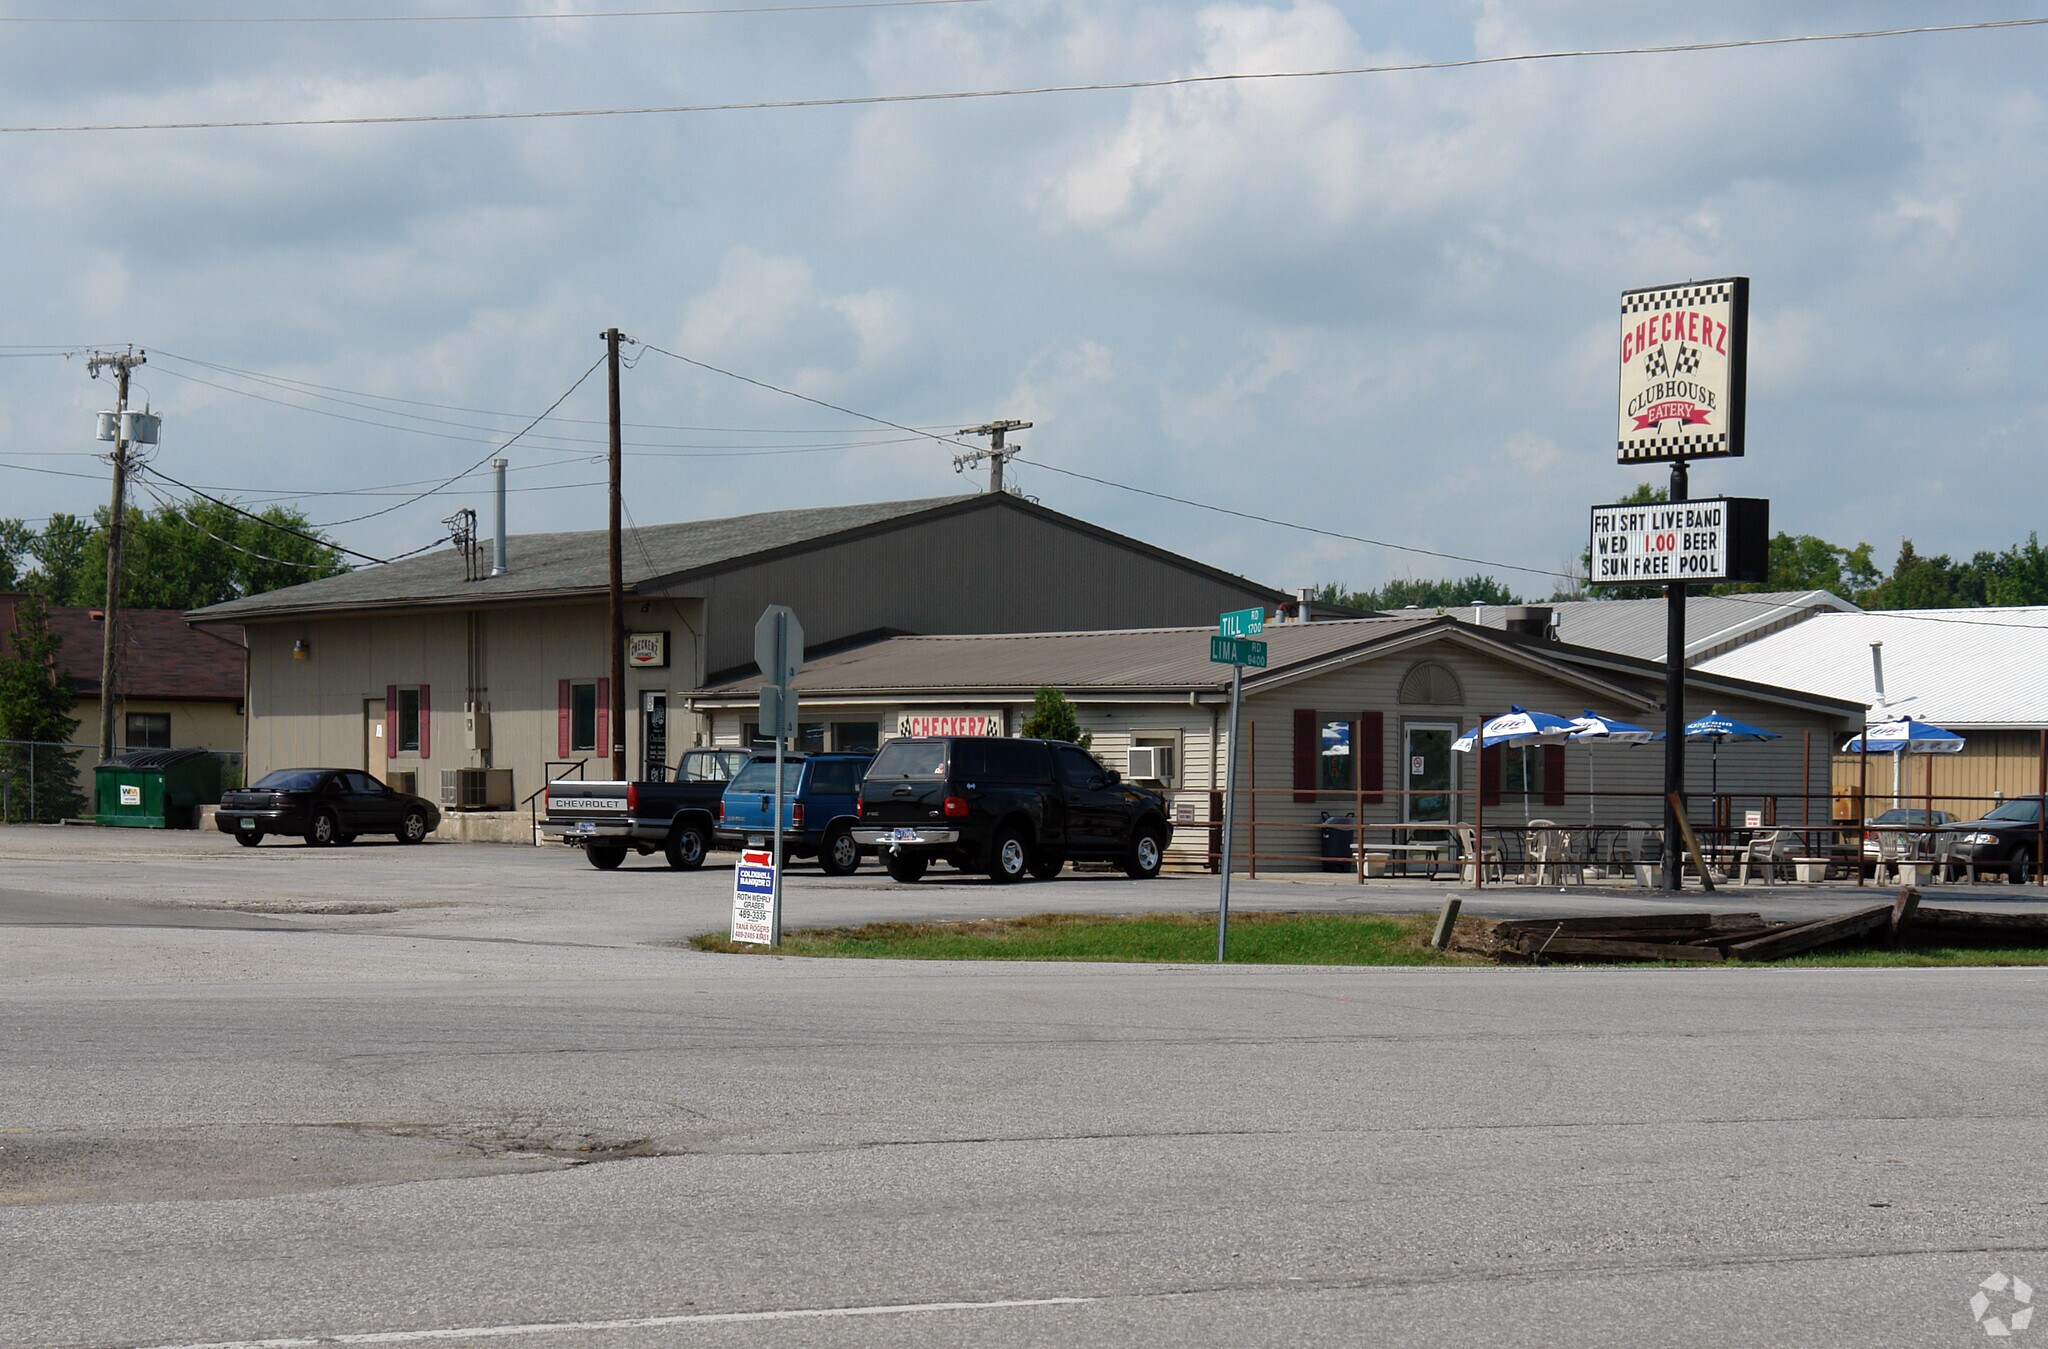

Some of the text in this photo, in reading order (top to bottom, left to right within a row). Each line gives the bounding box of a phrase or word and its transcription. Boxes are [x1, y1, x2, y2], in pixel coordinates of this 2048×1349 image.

[1622, 311, 1727, 365] CHECKERZ
[1627, 380, 1717, 417] CLUBHOUSE
[1648, 403, 1695, 422] EATERY
[1595, 508, 1722, 533] FRI SAT LIVE BAND
[1598, 531, 1717, 554] WED 1.00 BEER
[1601, 554, 1719, 577] SUN FREE POOL
[1223, 610, 1259, 636] TILL RD
[1248, 623, 1262, 633] 1700
[1212, 640, 1261, 661] LIMA RD
[1248, 655, 1265, 666] 9400
[912, 717, 985, 737] CHECKERZ
[555, 799, 620, 809] CHEVROLET
[737, 893, 751, 901] ROTH
